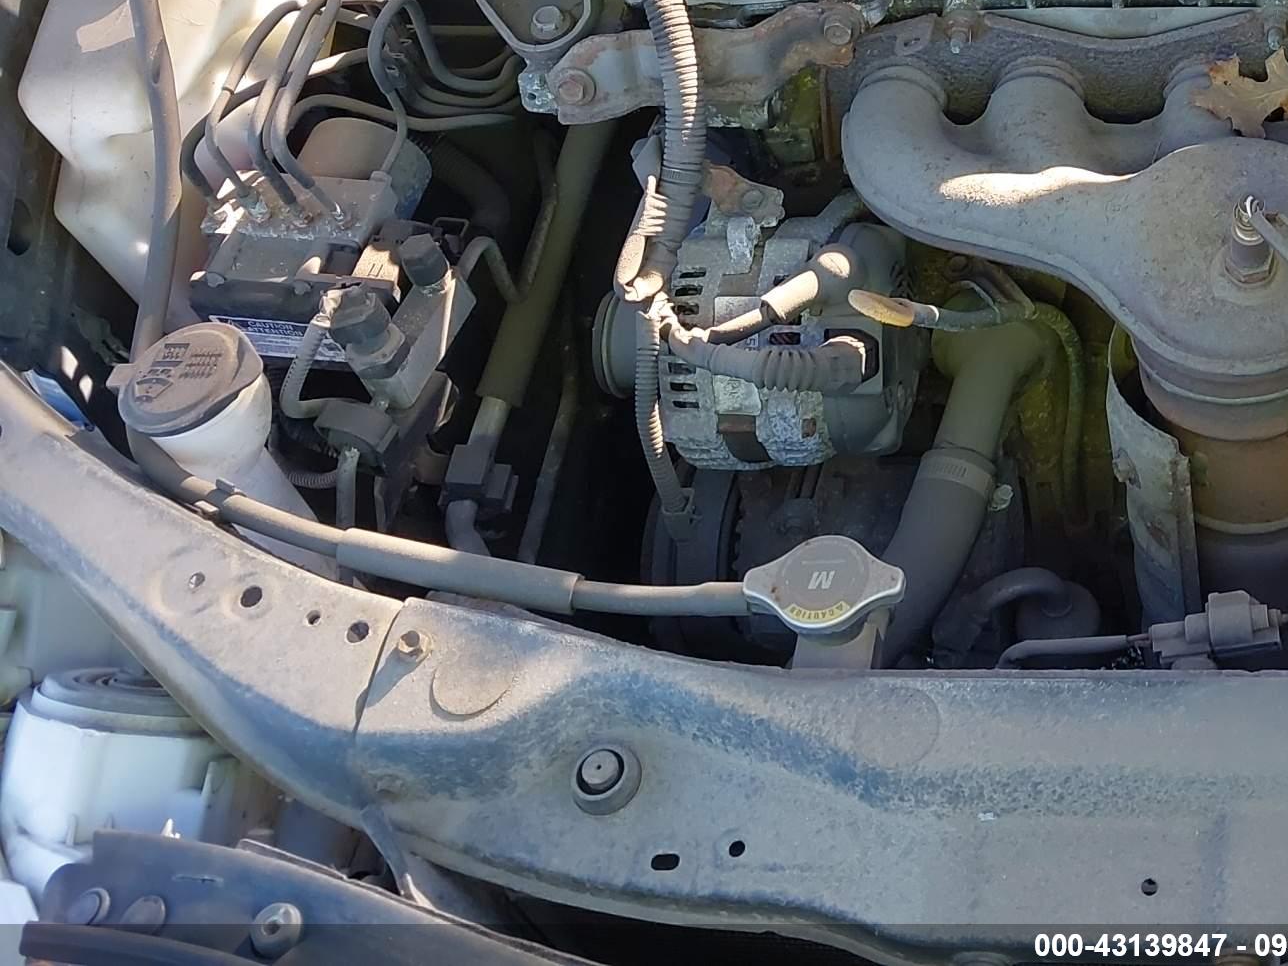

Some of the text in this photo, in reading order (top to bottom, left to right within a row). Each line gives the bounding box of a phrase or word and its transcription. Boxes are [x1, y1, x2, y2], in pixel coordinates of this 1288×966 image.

[247, 320, 294, 331] CAUTION
[247, 326, 304, 337] ATTENTION
[790, 606, 834, 619] CAUTION
